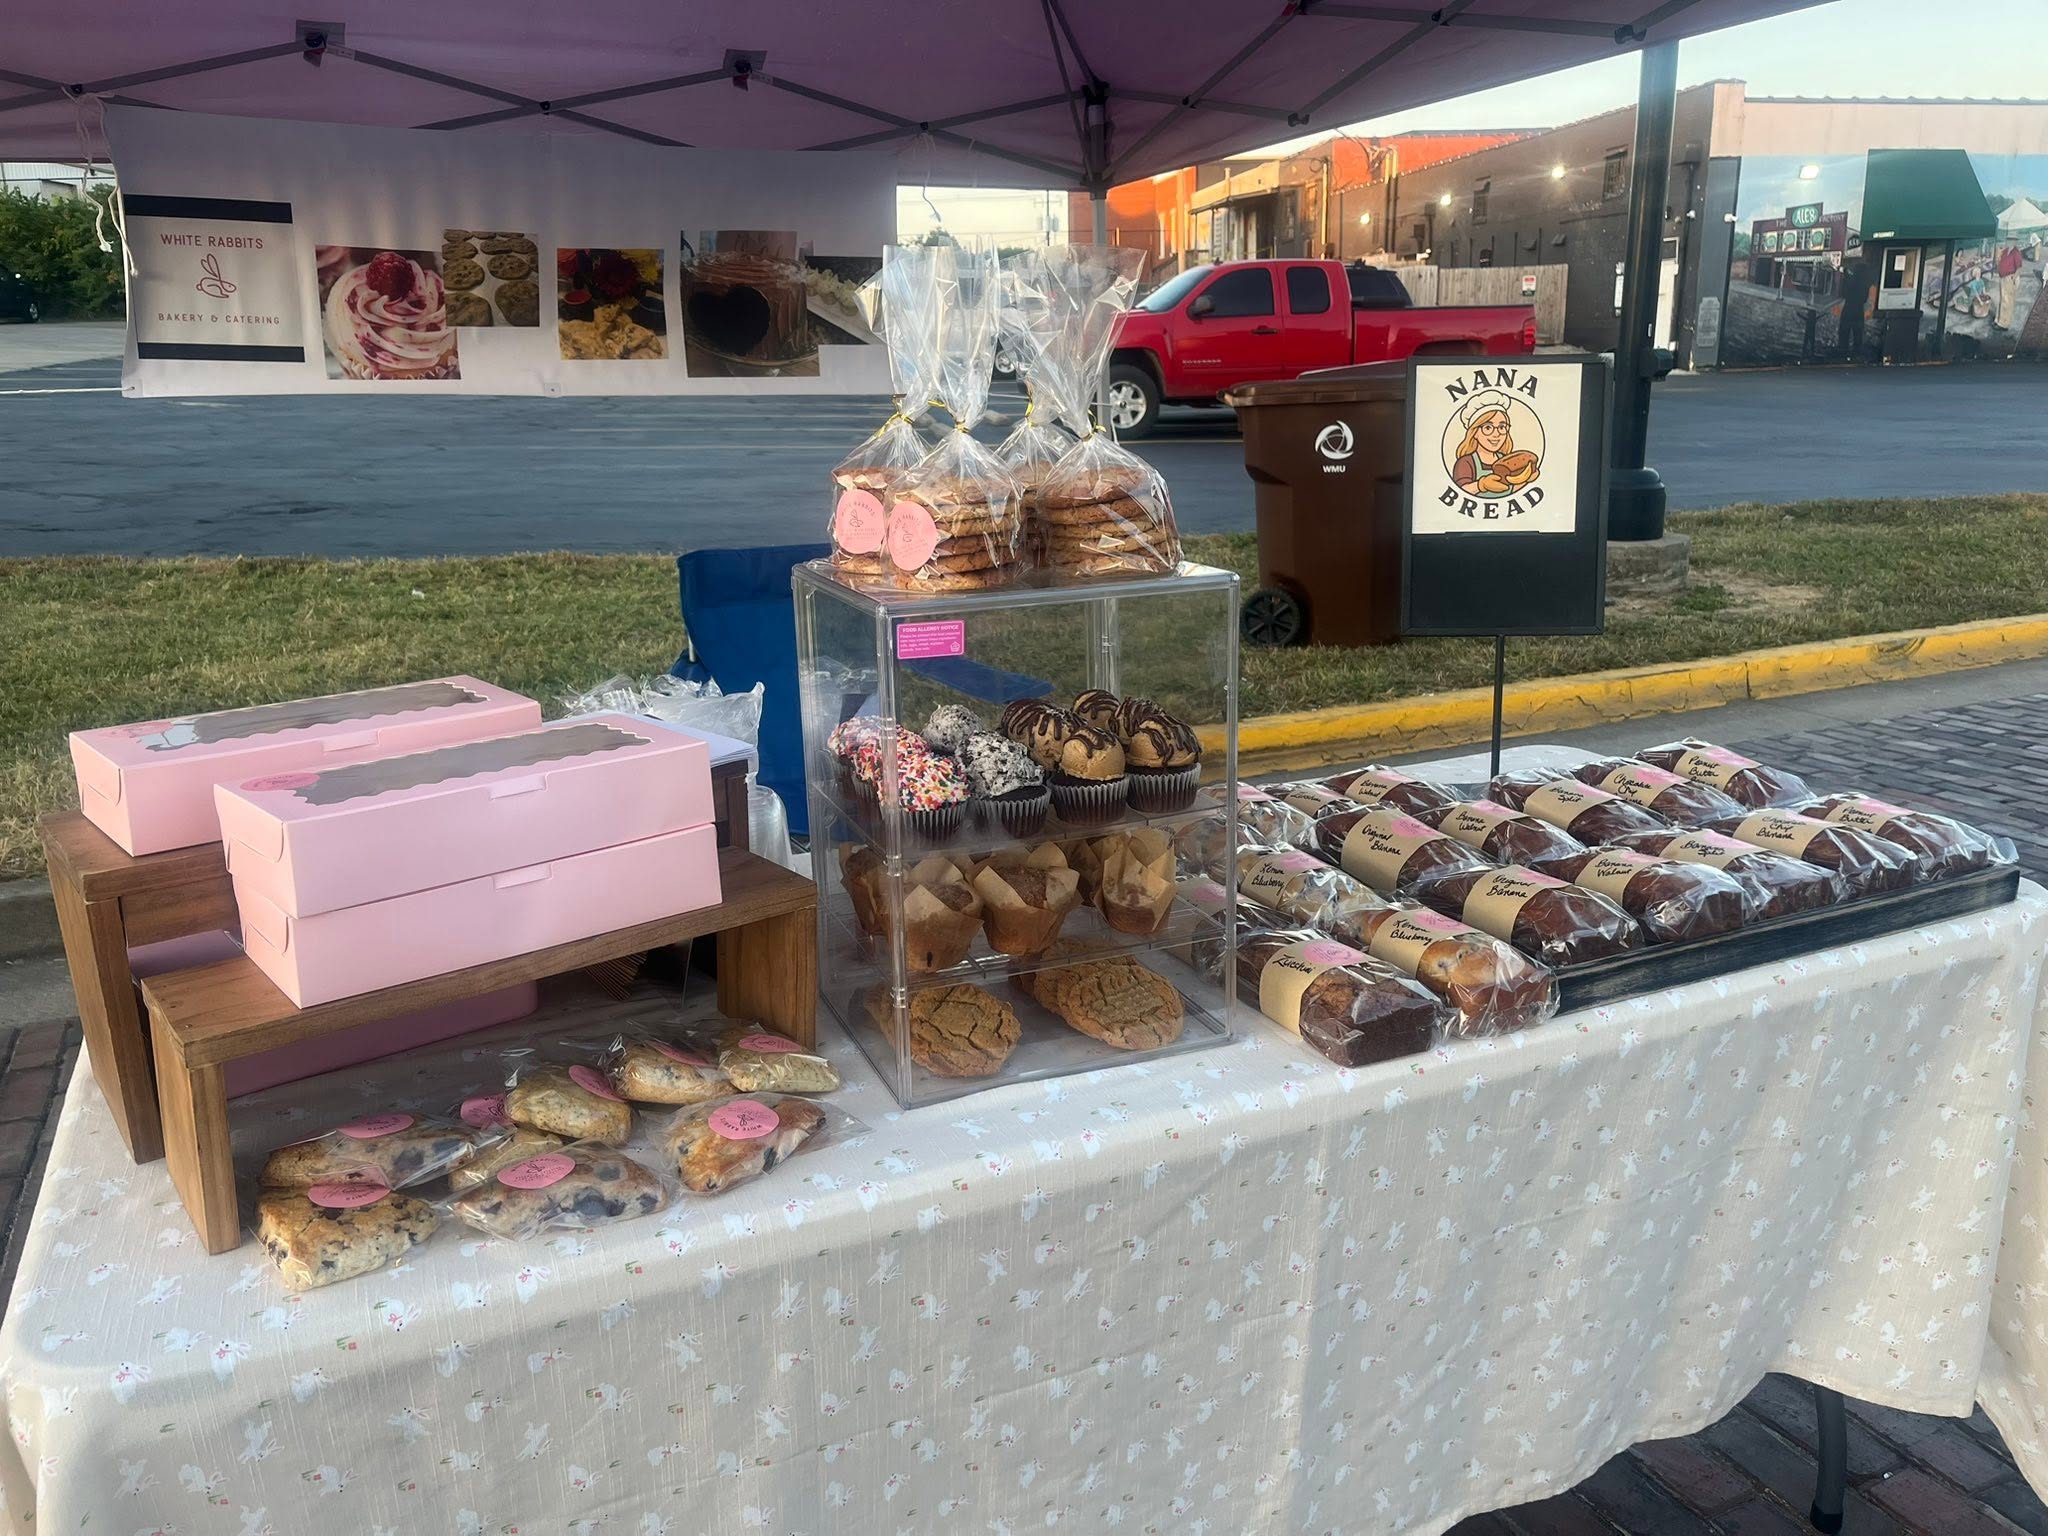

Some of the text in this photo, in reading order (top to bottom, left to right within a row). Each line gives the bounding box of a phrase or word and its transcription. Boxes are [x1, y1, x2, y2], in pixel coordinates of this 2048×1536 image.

[160, 233, 264, 250] WHITE RABBITS
[158, 312, 280, 325] BAKERY & CATERING
[1445, 367, 1539, 403] NANA
[1322, 464, 1346, 474] WMU
[1438, 485, 1545, 520] BREAD
[1361, 823, 1394, 842] Original
[1370, 841, 1402, 856] Banana
[1597, 867, 1632, 877] Walnut
[1486, 884, 1529, 898] Banana
[1393, 918, 1431, 933] Lemon
[1272, 953, 1316, 974] Zucchini
